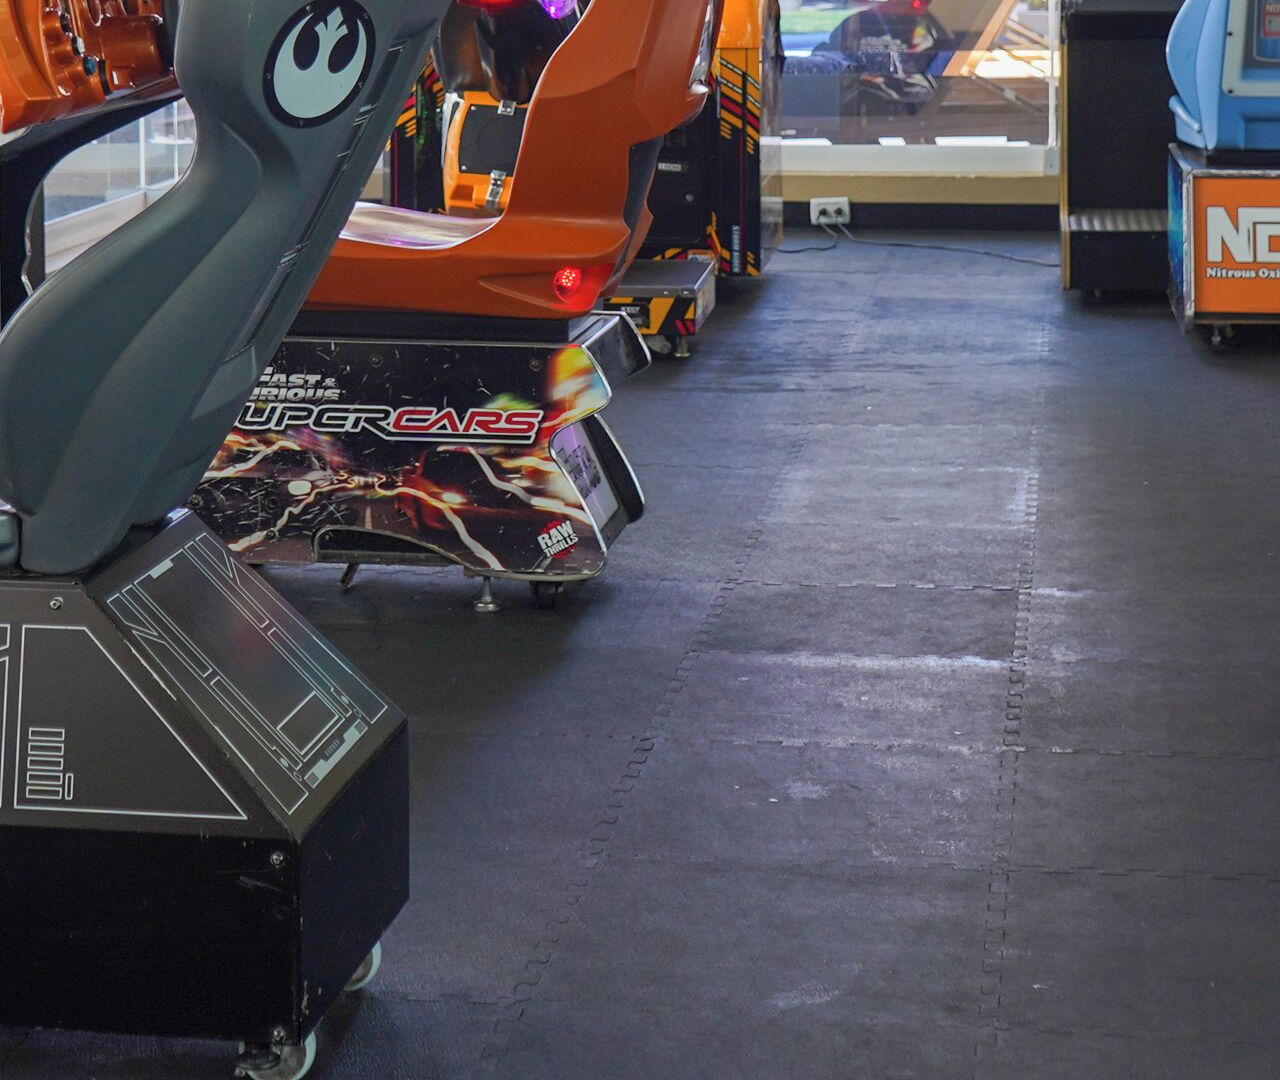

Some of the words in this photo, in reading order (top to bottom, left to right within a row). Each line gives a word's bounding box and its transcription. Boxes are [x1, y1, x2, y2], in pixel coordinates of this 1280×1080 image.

[1206, 266, 1257, 279] Nitrous
[249, 387, 342, 402] RIOUS
[233, 402, 545, 444] UPERCARS
[537, 520, 574, 551] RAW
[542, 533, 579, 558] THRILLS
